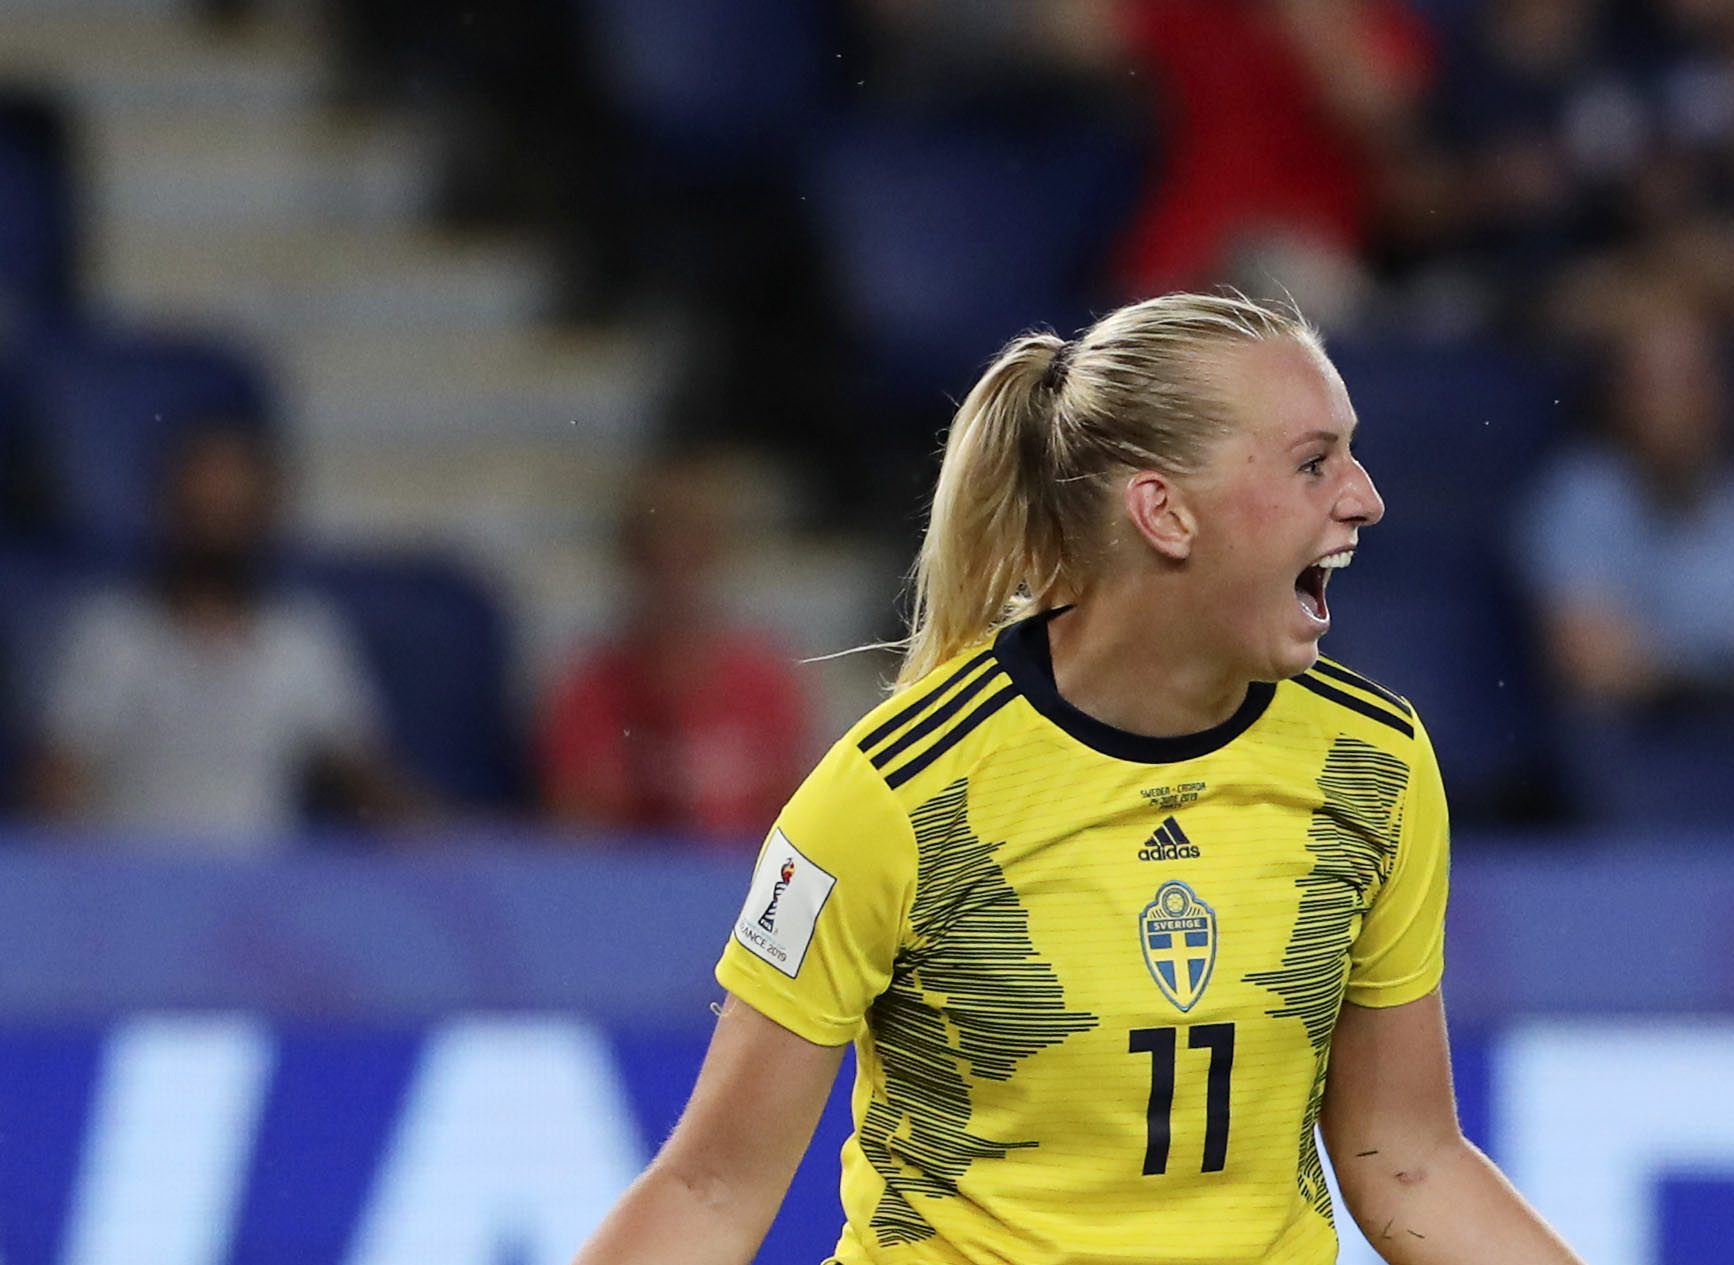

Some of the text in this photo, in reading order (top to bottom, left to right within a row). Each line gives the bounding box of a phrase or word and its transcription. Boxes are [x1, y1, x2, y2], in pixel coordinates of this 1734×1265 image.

[1138, 845, 1201, 861] adidas
[1153, 919, 1202, 931] SVERIGE
[740, 923, 767, 950] ANCE
[766, 943, 788, 962] 2019
[1128, 1022, 1235, 1176] 11
